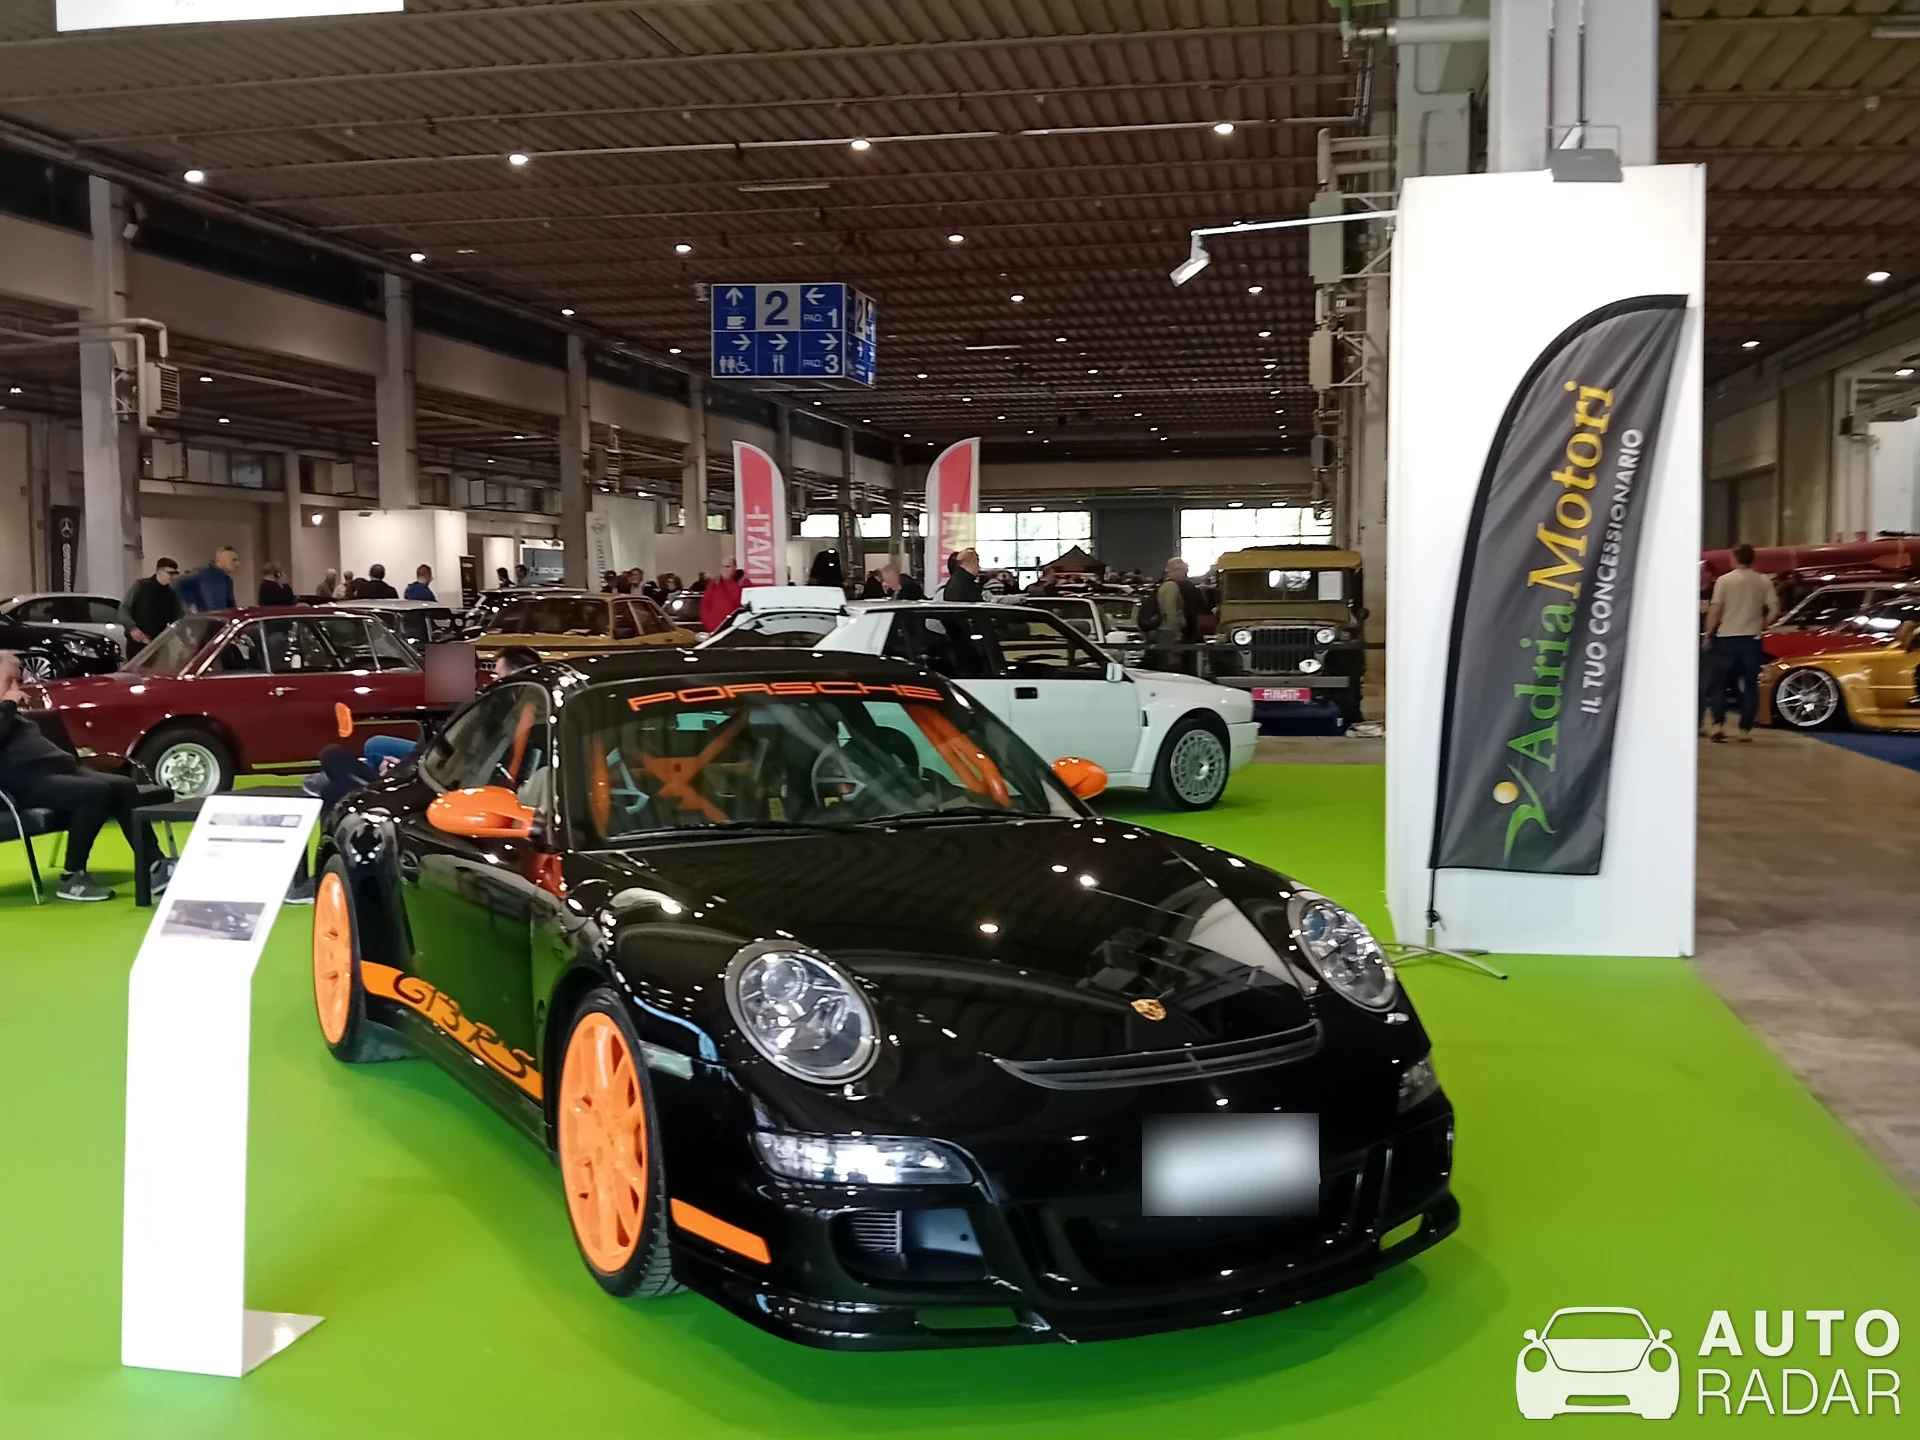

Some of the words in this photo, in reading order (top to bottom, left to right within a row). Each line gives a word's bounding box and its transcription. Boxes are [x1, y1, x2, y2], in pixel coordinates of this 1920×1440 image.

[764, 290, 790, 326] 2
[827, 308, 838, 328] 1
[825, 354, 839, 374] 3
[1588, 428, 1643, 635] CONCESSIONARIO
[1507, 379, 1614, 772] AdriaMotori
[1582, 641, 1608, 689] TUO
[627, 681, 944, 712] PORSCHE
[1580, 696, 1603, 714] IL
[393, 973, 460, 1033] GT3
[467, 1021, 536, 1080] RS
